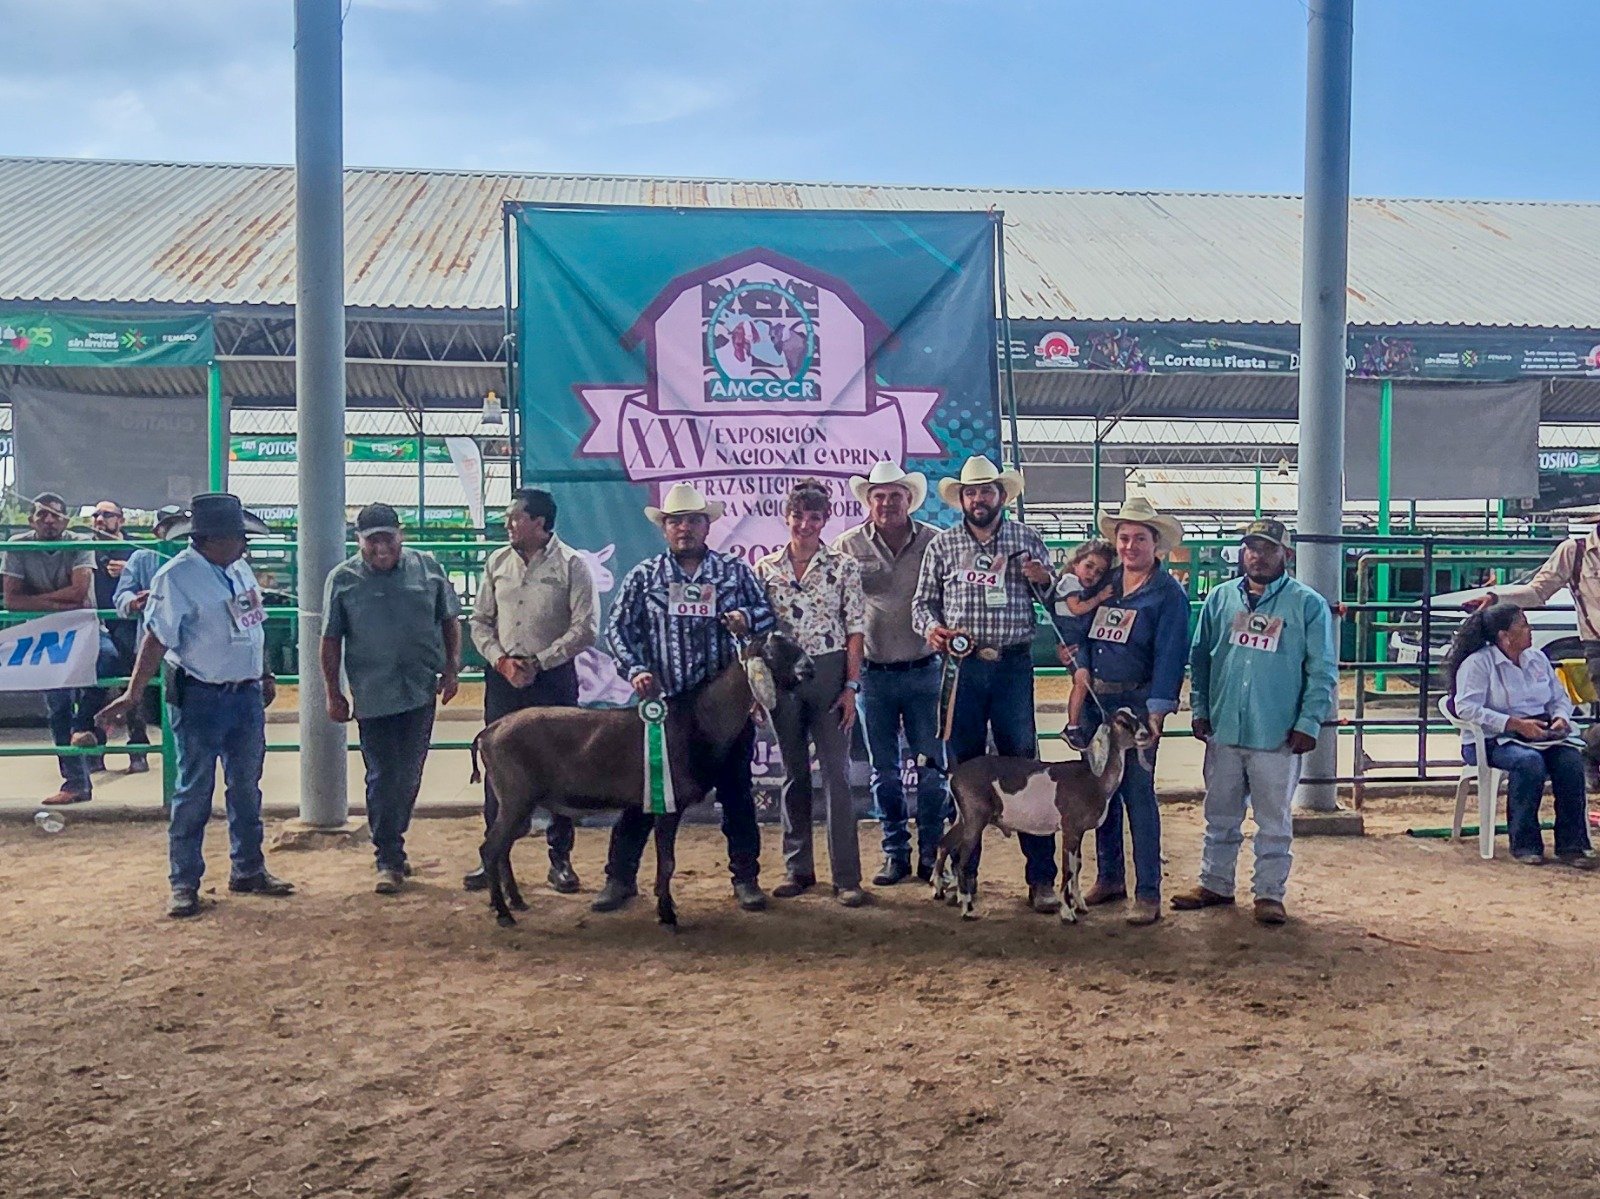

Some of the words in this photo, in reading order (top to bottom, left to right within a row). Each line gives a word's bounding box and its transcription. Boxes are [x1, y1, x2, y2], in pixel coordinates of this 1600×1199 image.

[710, 380, 815, 397] AMCGCR
[627, 417, 713, 468] XXV
[715, 423, 827, 445] EXPOSICIÓN
[715, 448, 808, 465] NACIONAL
[814, 448, 892, 465] CAPRINA
[705, 477, 754, 495] RAZAS
[966, 571, 996, 584] 024
[677, 603, 708, 615] 018
[240, 610, 263, 628] 020
[1096, 627, 1122, 641] 010
[1238, 634, 1269, 650] 011
